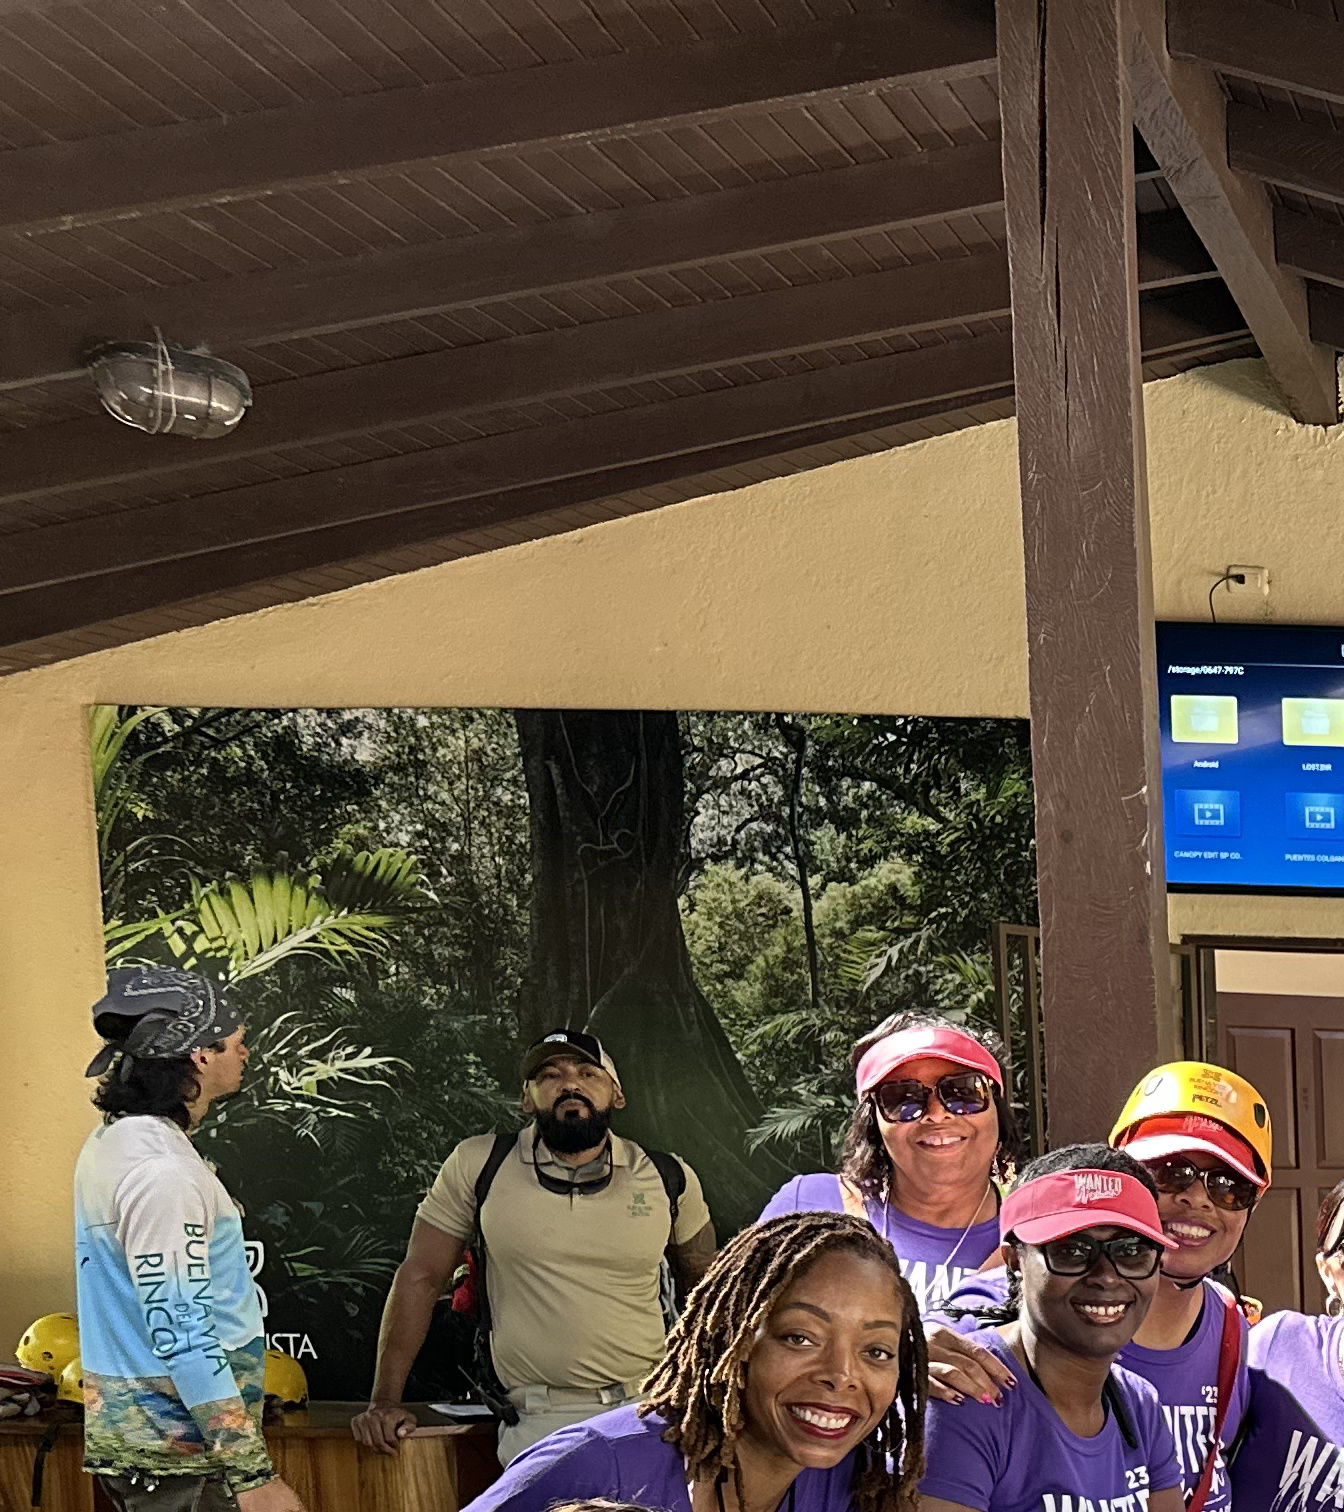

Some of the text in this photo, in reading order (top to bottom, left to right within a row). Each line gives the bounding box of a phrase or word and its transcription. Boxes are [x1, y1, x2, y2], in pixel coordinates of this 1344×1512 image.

[1074, 1174, 1122, 1197] WANTED
[184, 1222, 214, 1322] BUENA
[134, 1253, 179, 1358] RINCO
[174, 1303, 192, 1328] DEL
[265, 1333, 318, 1359] ISTA
